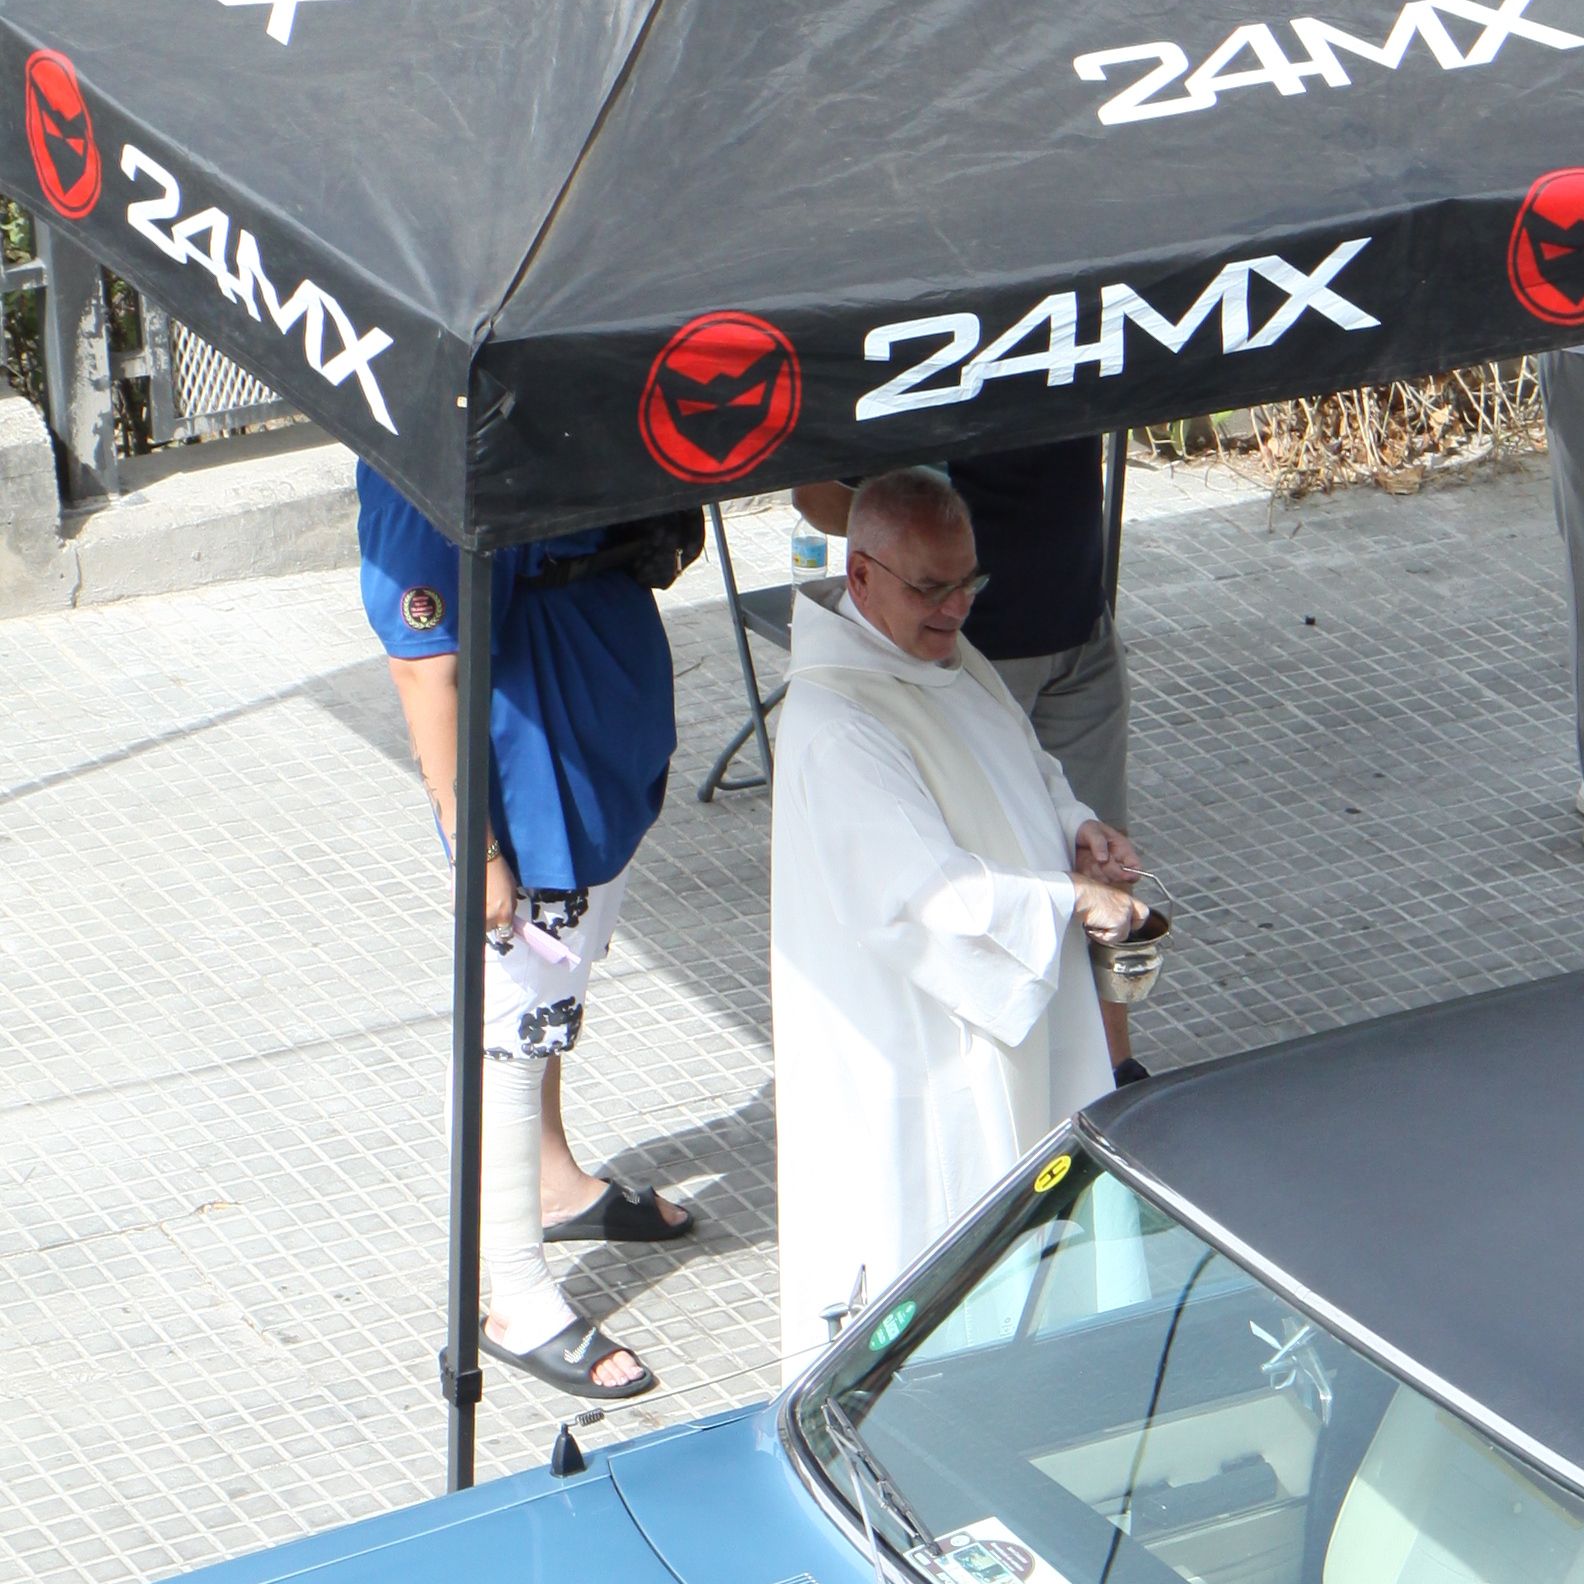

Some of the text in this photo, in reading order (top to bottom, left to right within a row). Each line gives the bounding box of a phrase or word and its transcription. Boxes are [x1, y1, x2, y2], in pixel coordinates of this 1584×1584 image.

[120, 143, 399, 436] 24MX
[855, 237, 1381, 421] 24MX
[1038, 1159, 1067, 1189] H
